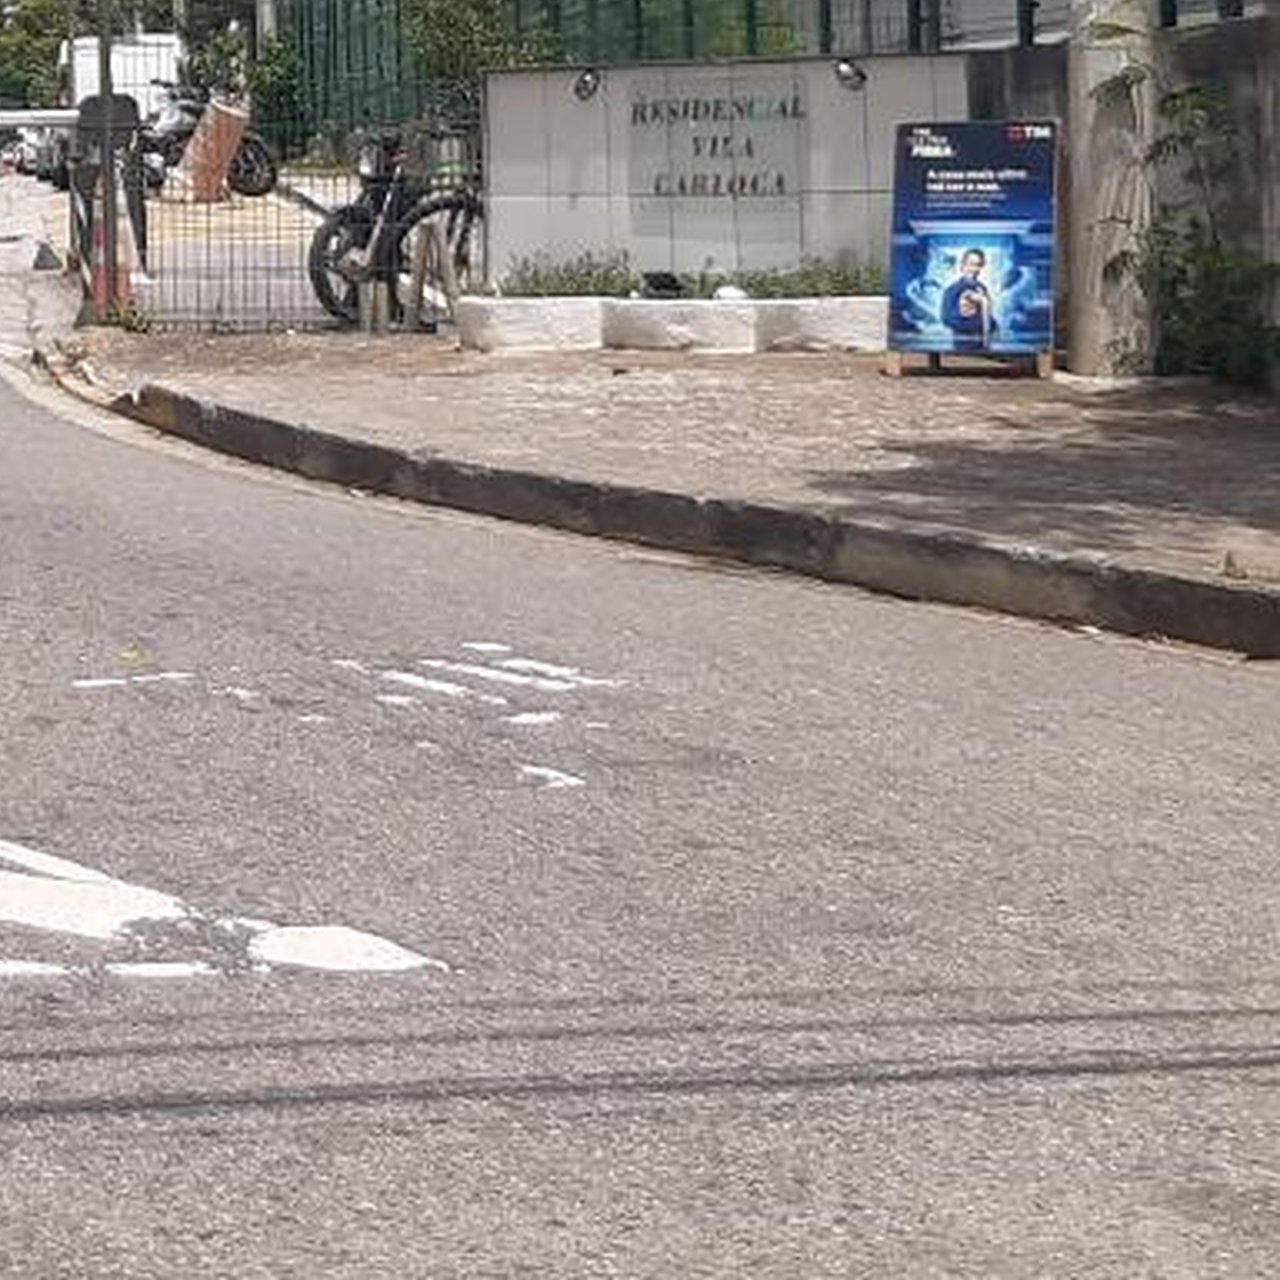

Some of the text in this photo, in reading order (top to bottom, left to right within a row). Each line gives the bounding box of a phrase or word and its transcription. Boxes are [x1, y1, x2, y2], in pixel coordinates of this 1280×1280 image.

[630, 94, 807, 127] RESIDENCIAL
[692, 134, 755, 159] VILA
[653, 172, 787, 198] CARIOCA
